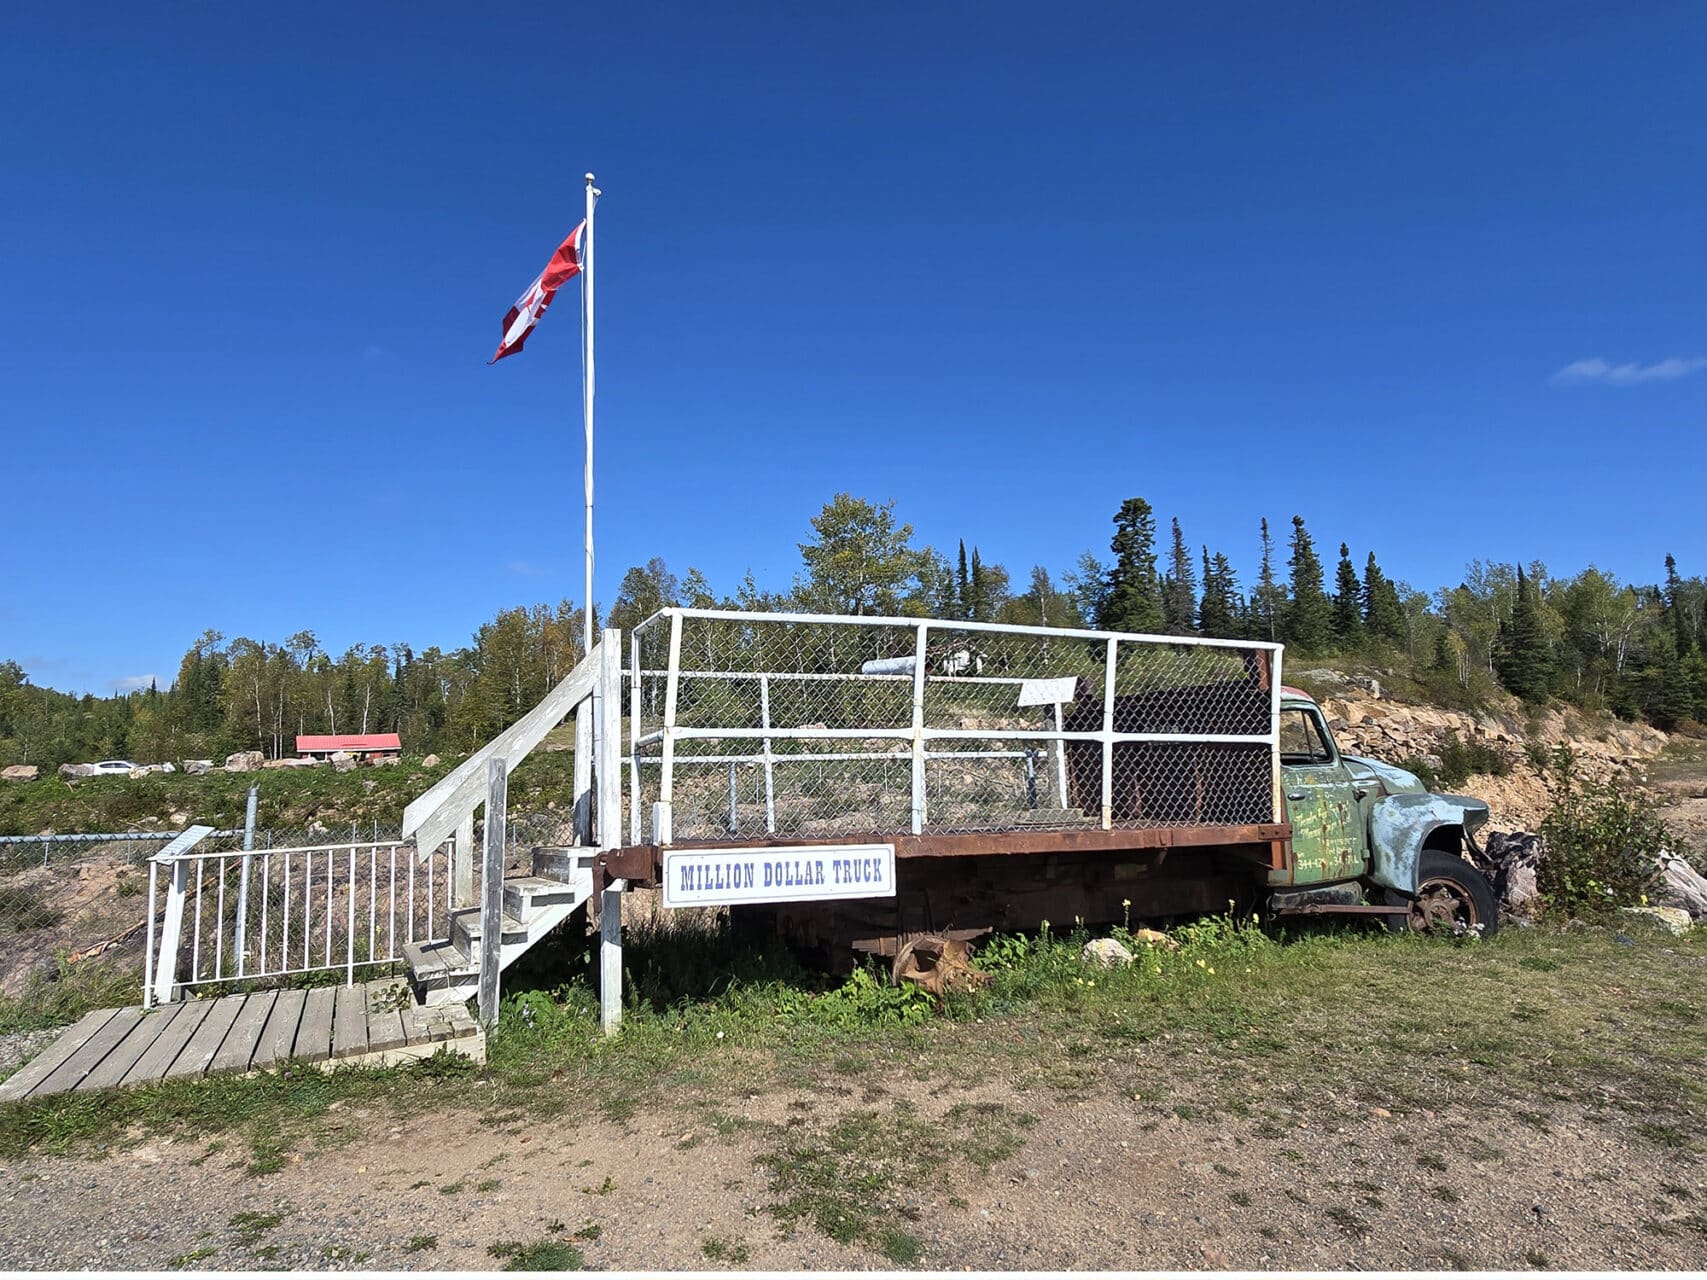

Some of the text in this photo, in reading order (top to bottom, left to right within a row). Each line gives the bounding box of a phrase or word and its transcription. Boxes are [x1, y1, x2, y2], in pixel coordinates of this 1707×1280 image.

[681, 858, 882, 891] MILLION DOLLAR TRUCK
